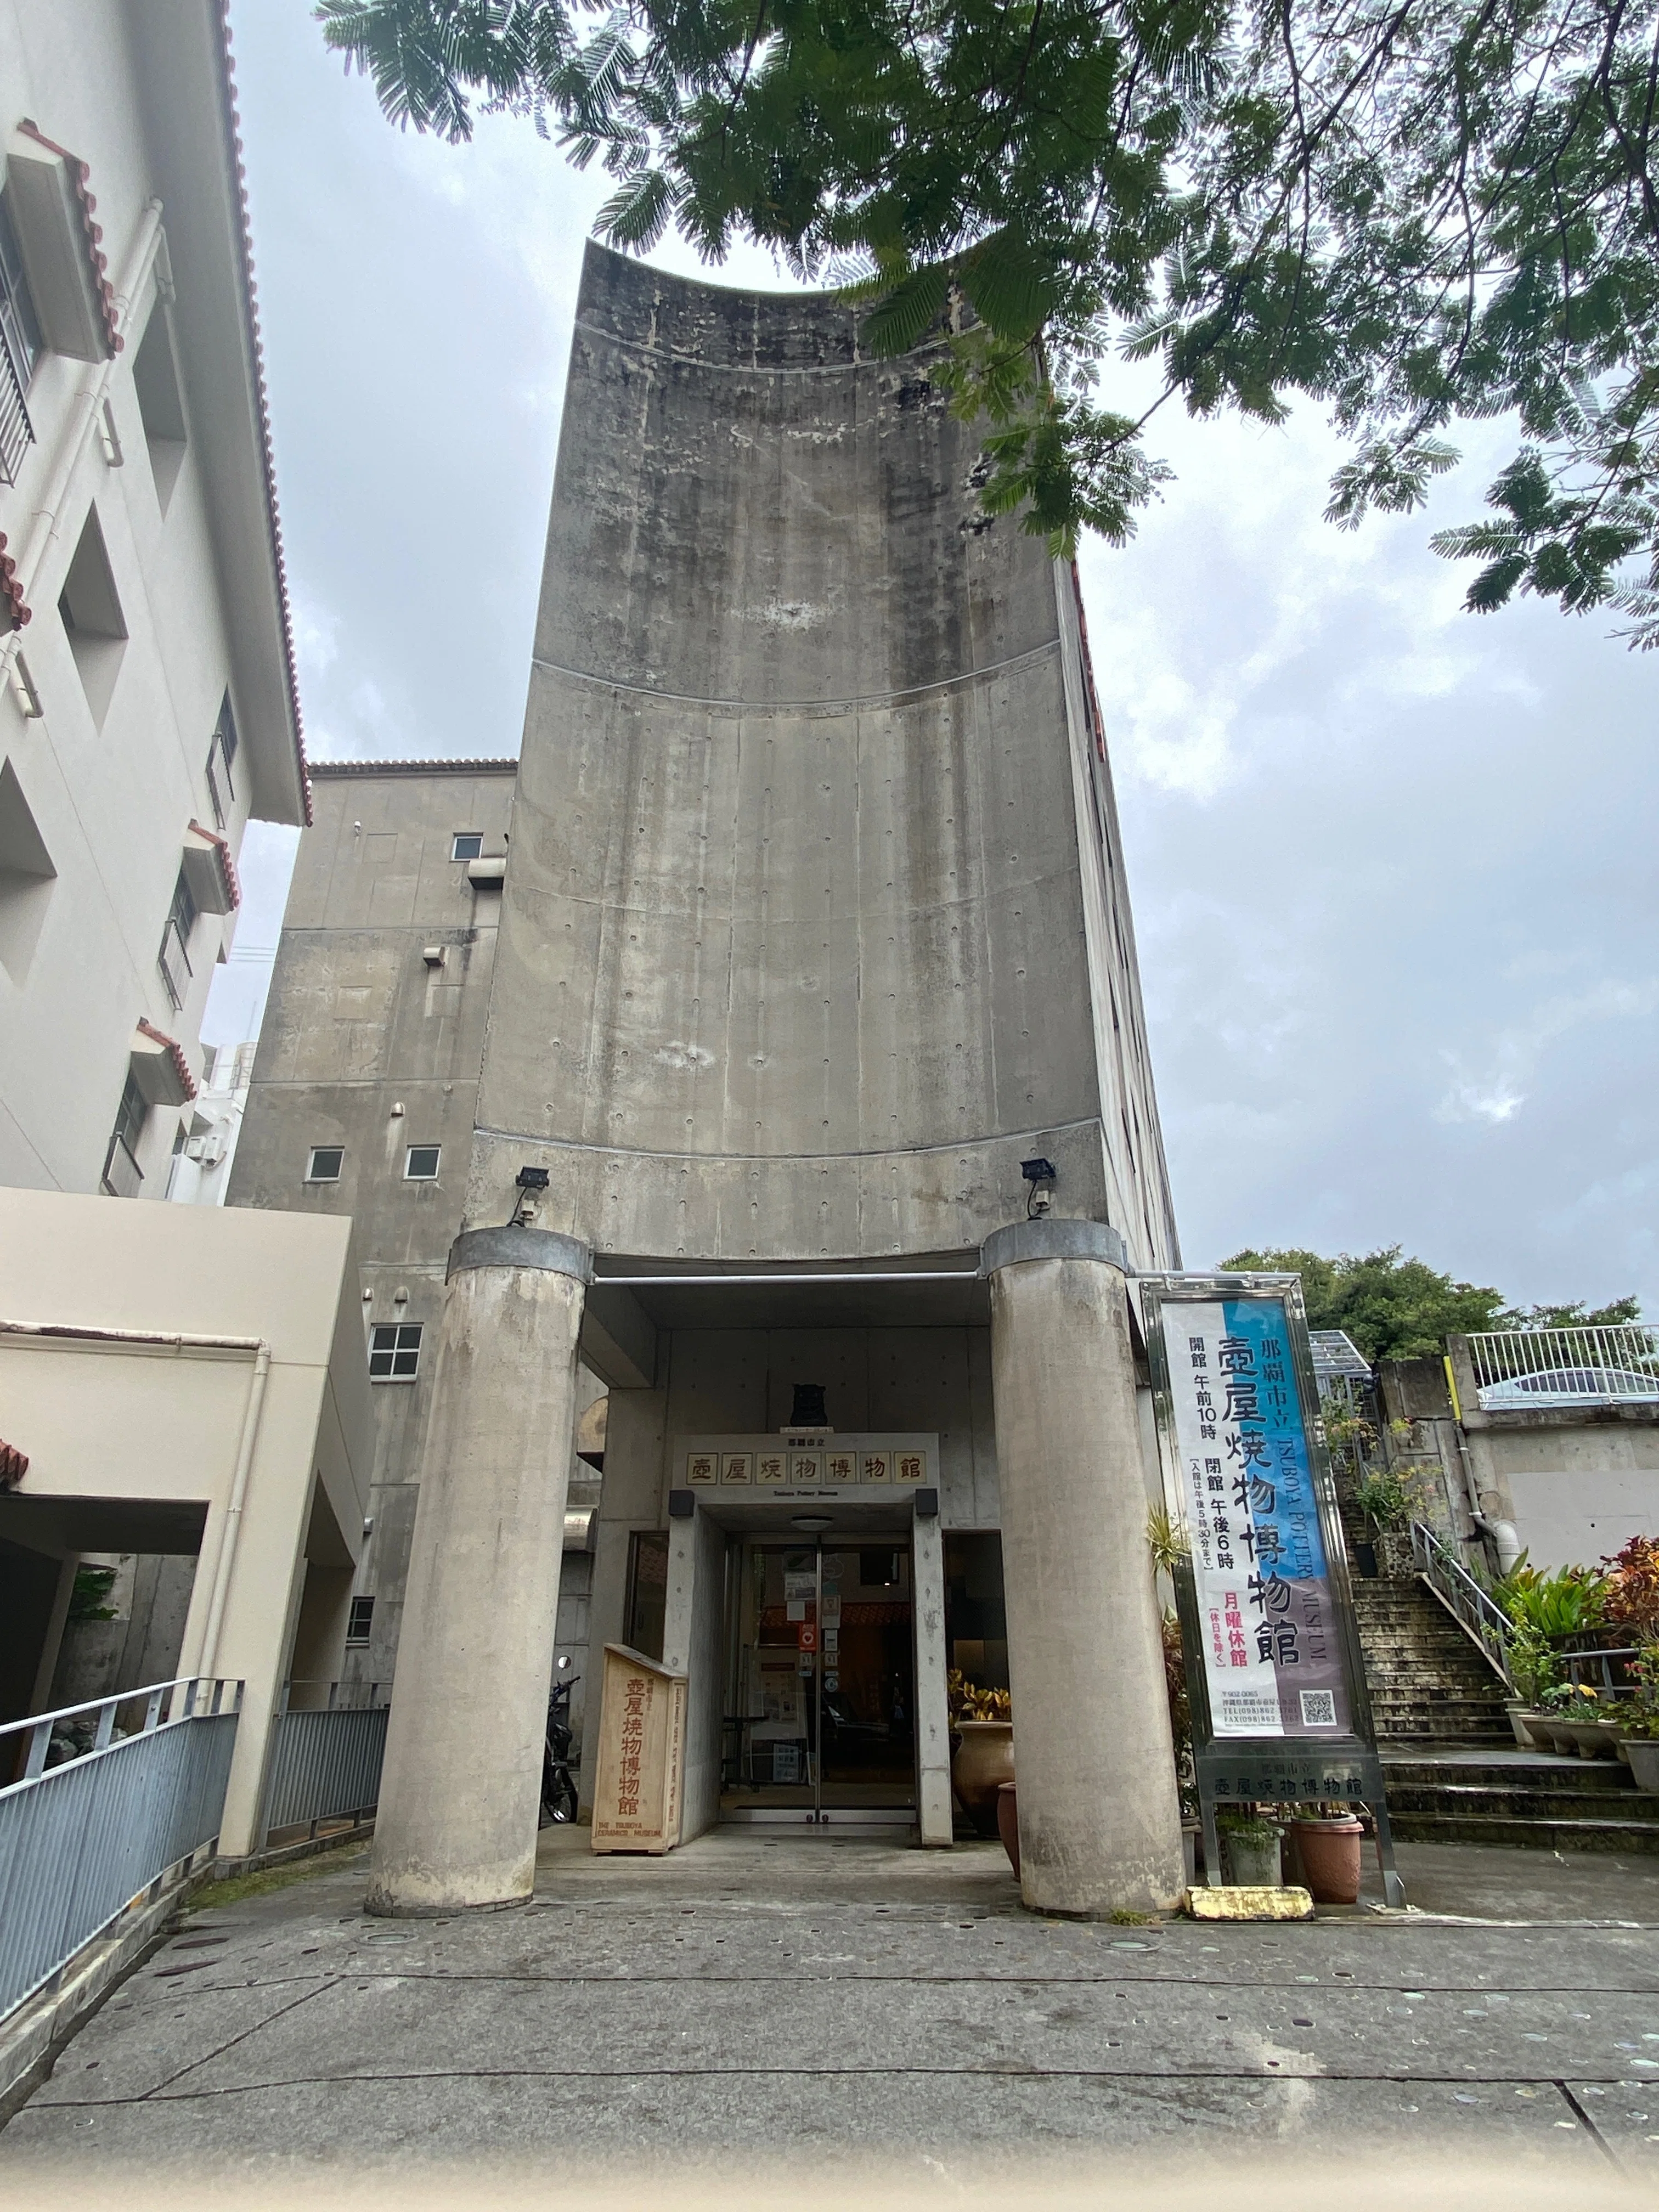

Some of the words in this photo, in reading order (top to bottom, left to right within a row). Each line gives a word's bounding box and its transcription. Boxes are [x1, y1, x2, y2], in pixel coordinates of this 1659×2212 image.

[1189, 1337, 1207, 1368] 開館
[1261, 1338, 1294, 1430] 那覇市立
[1194, 1374, 1216, 1440] 午前10時
[1205, 1458, 1224, 1491] 閉館
[1218, 1336, 1299, 1666] 壺屋焼物博物館
[1277, 1437, 1302, 1504] TSUBOYA
[1211, 1498, 1234, 1569] 午後6時
[1288, 1511, 1314, 1579] POTTERY
[1224, 1592, 1248, 1667] 月曜休館
[1302, 1591, 1327, 1659] MUSEUM
